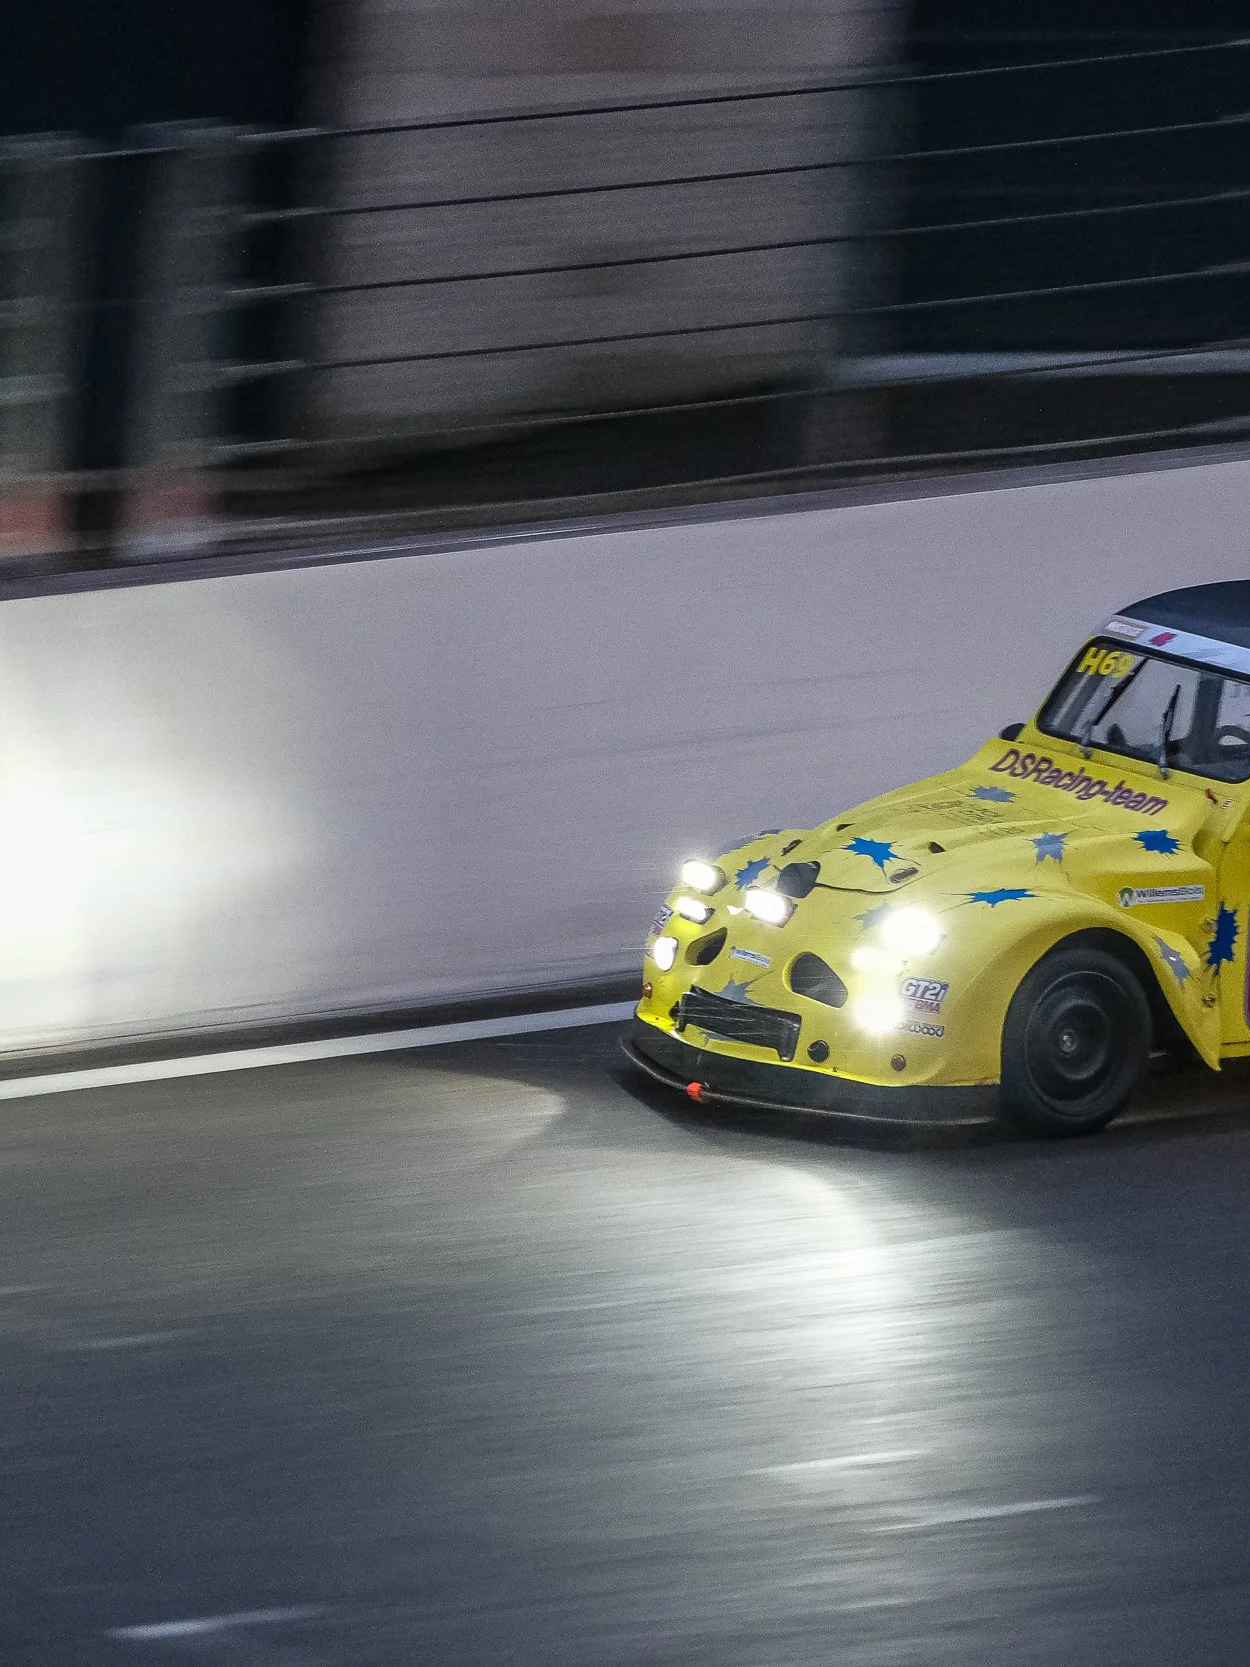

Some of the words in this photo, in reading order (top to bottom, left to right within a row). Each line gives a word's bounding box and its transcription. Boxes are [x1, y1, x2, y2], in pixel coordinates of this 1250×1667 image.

[1077, 647, 1136, 678] H69
[989, 748, 1168, 816] DSRacing-team
[900, 978, 949, 1002] GT2i
